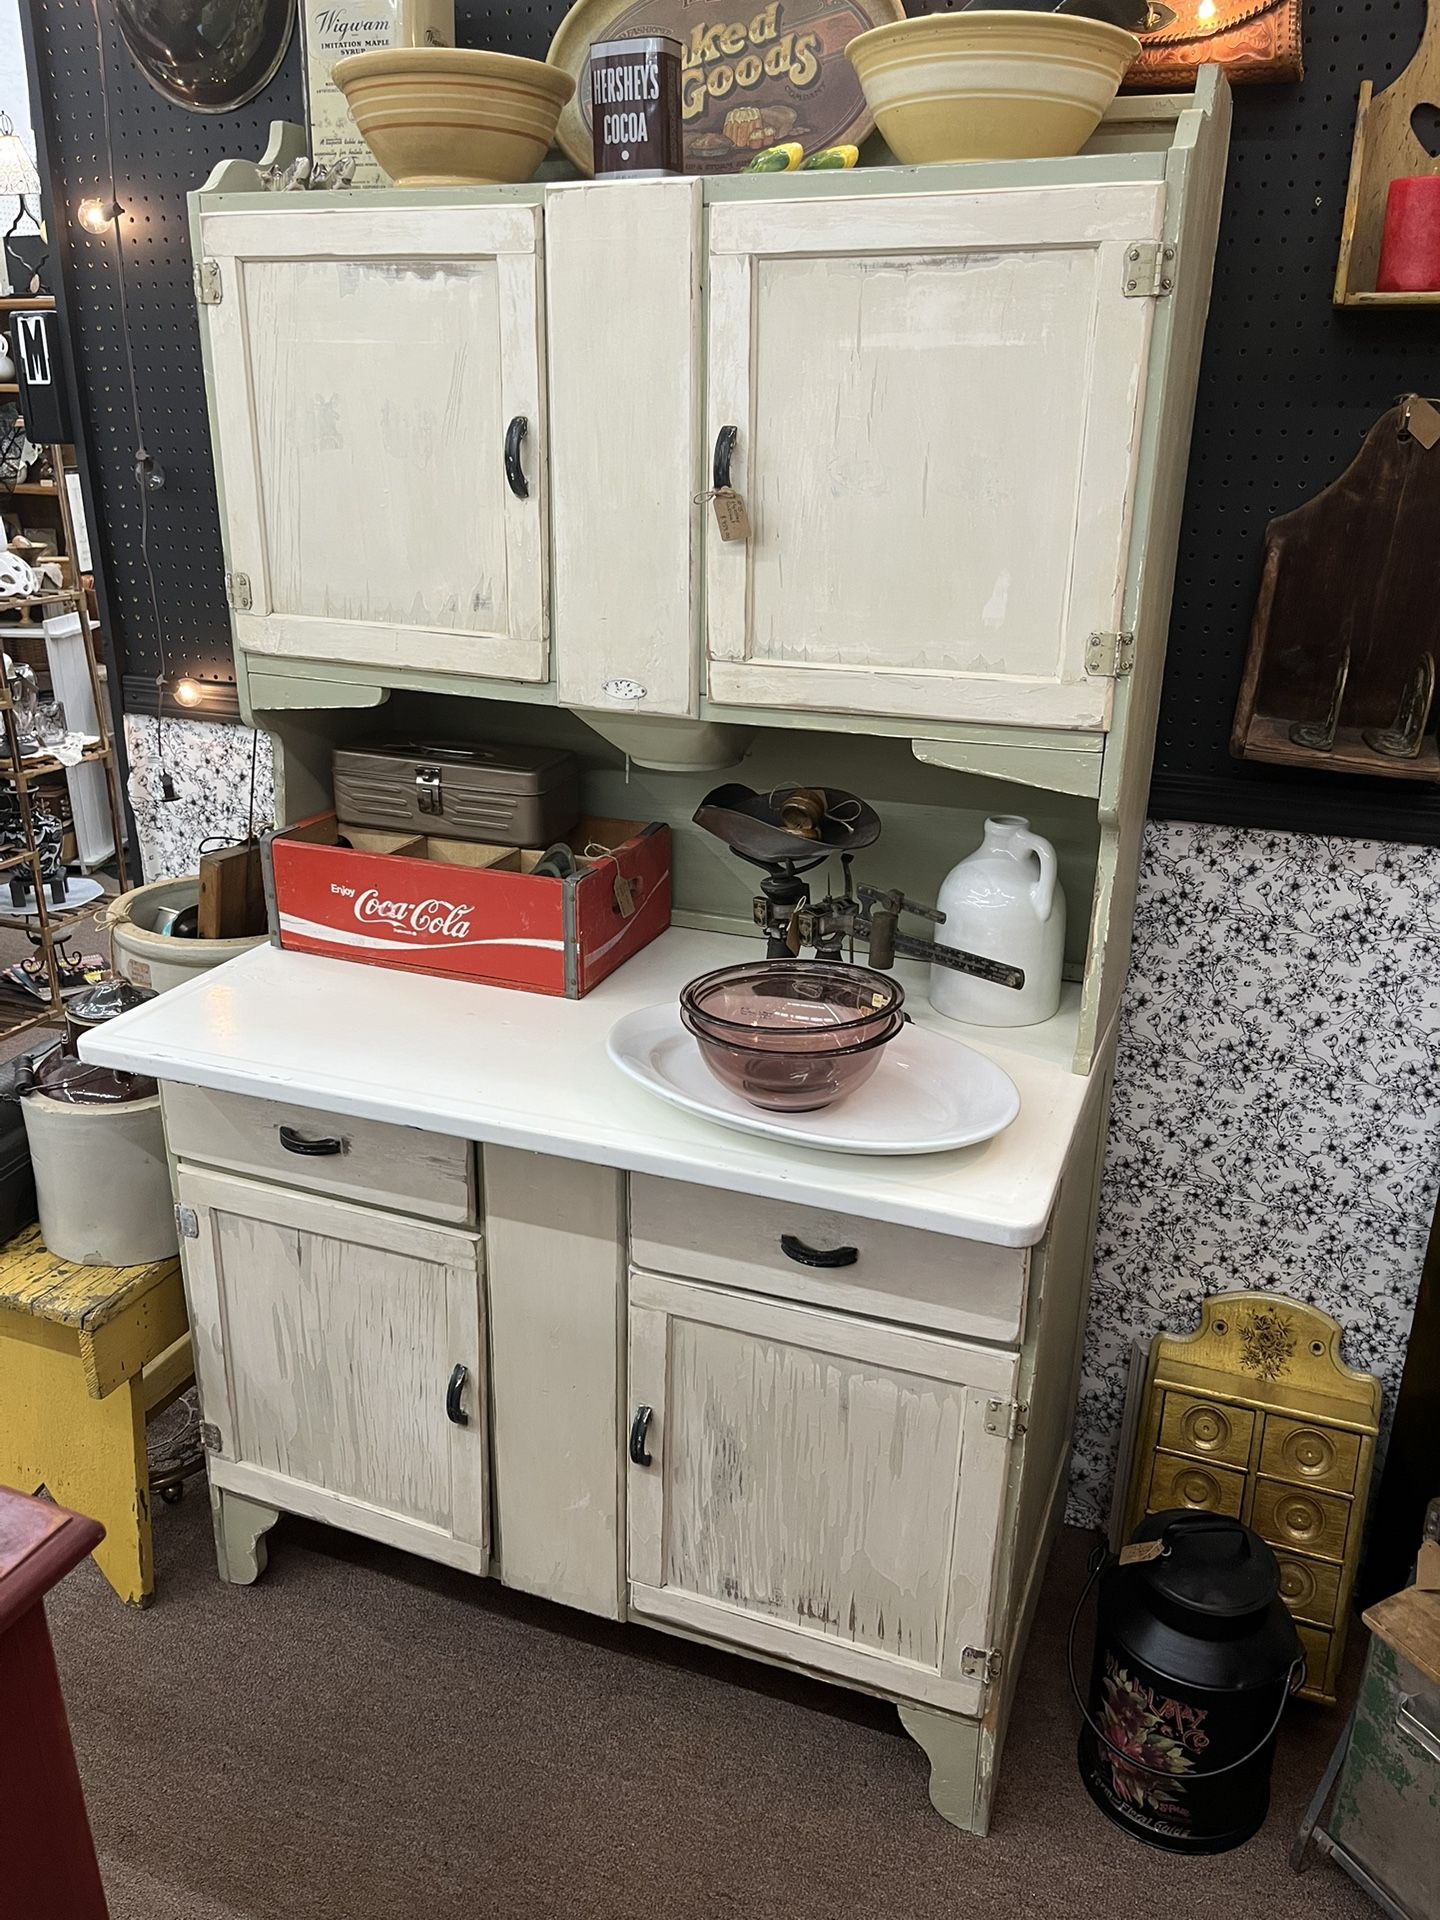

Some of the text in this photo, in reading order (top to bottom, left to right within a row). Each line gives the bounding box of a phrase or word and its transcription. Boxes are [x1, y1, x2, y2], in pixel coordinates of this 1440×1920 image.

[315, 8, 390, 41] Wigwam
[321, 39, 389, 49] IMITATION MAPLE
[341, 48, 366, 56] SYRUP
[682, 32, 818, 119] Goods
[604, 112, 648, 145] COCOA
[331, 883, 475, 938] Enjoy Coca-Cola
